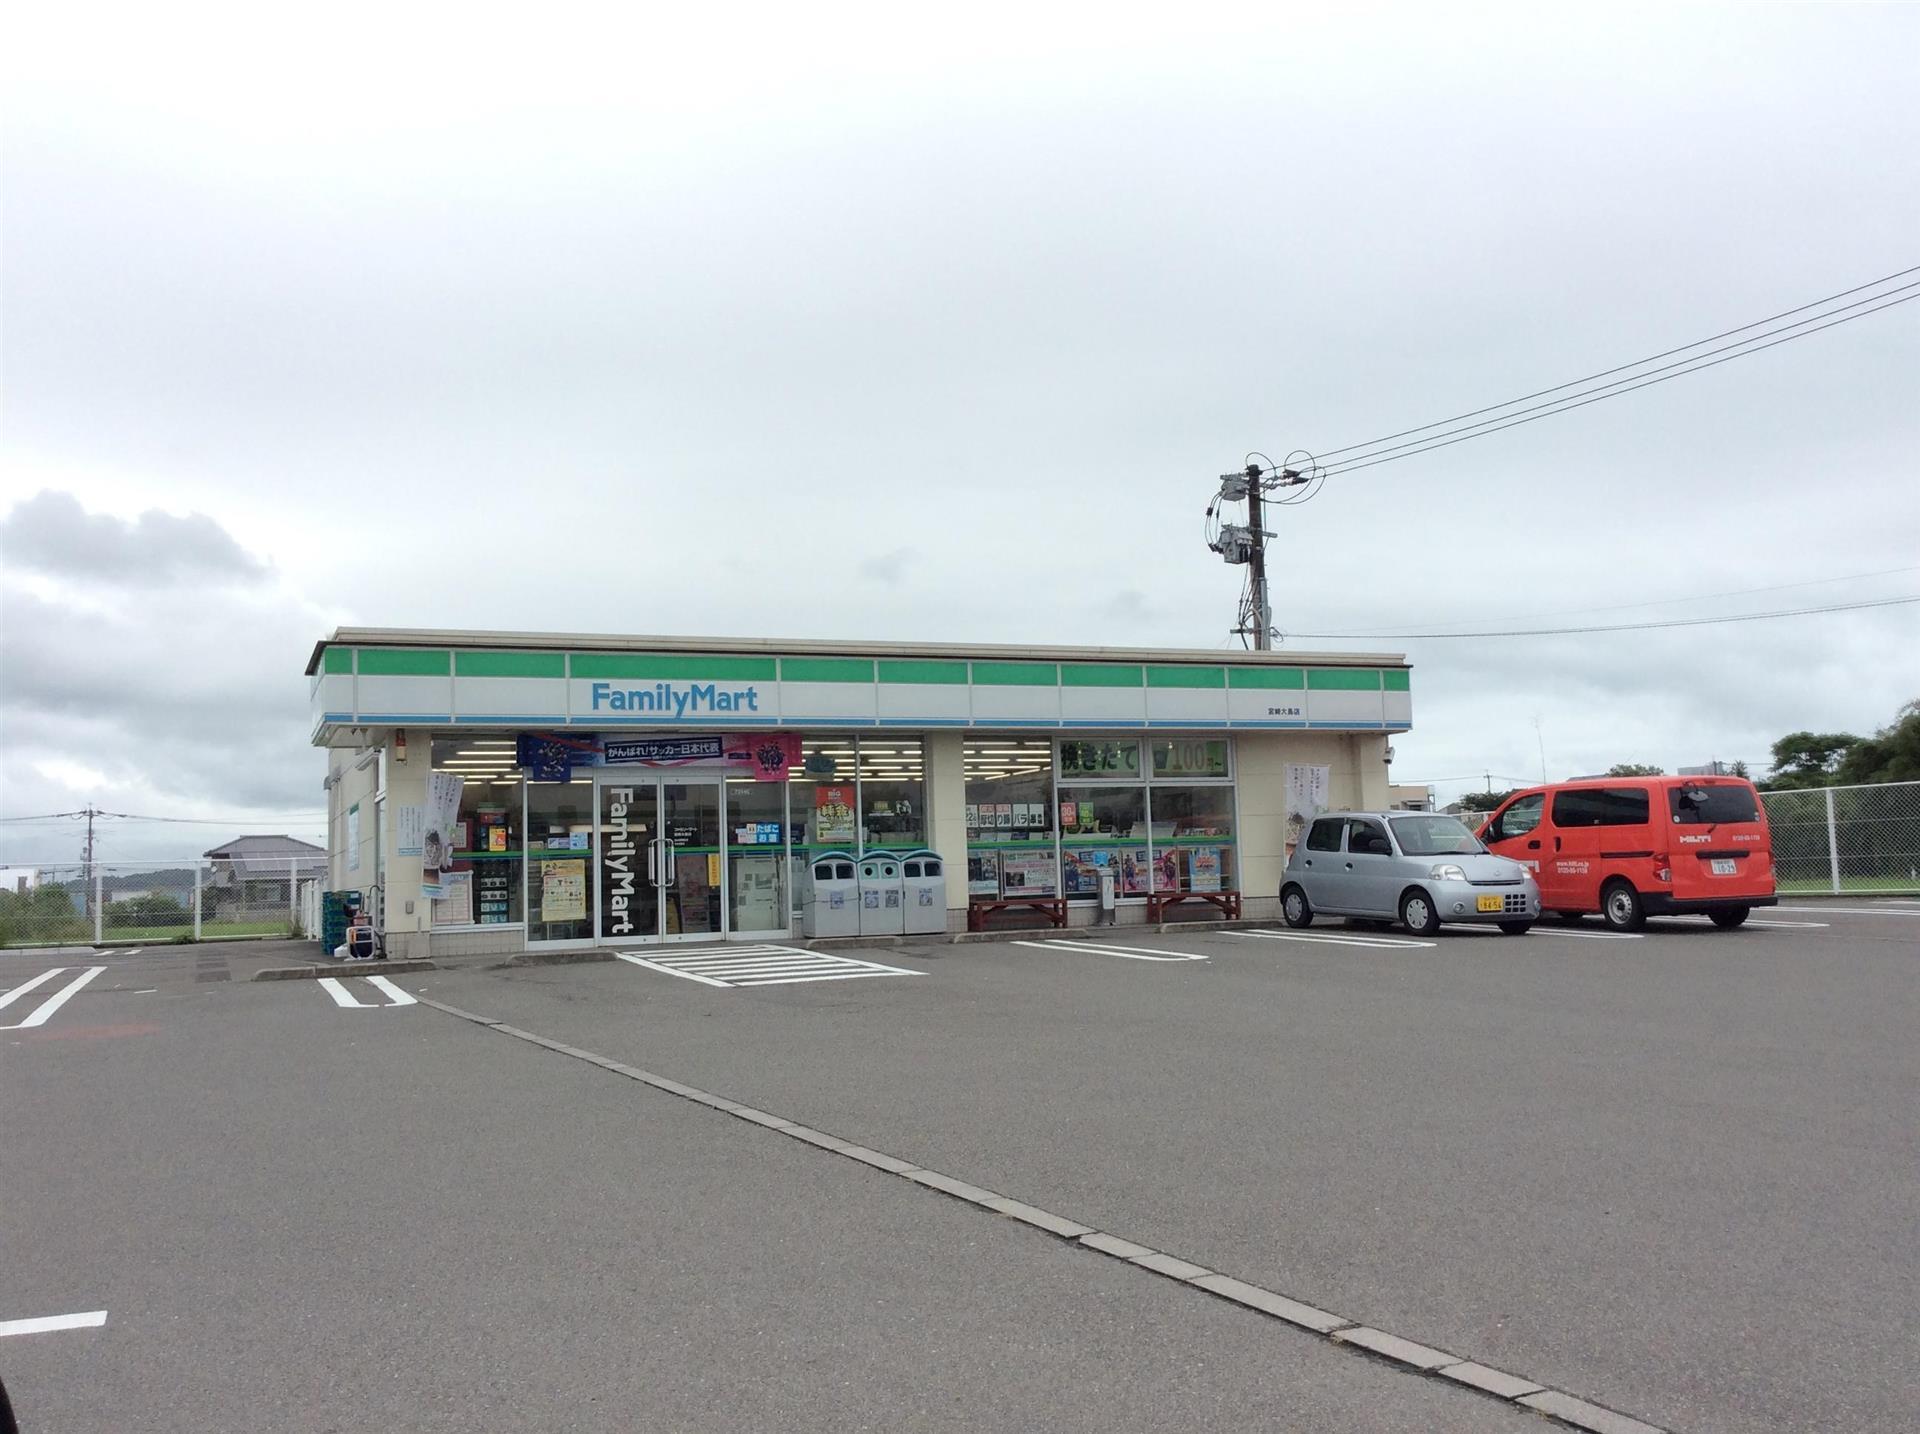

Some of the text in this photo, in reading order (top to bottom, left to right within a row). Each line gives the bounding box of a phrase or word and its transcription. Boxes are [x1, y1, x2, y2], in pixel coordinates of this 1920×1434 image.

[592, 683, 758, 719] FamilyMart
[1680, 835, 1712, 843] HILTI
[604, 788, 636, 934] FamilyMart
